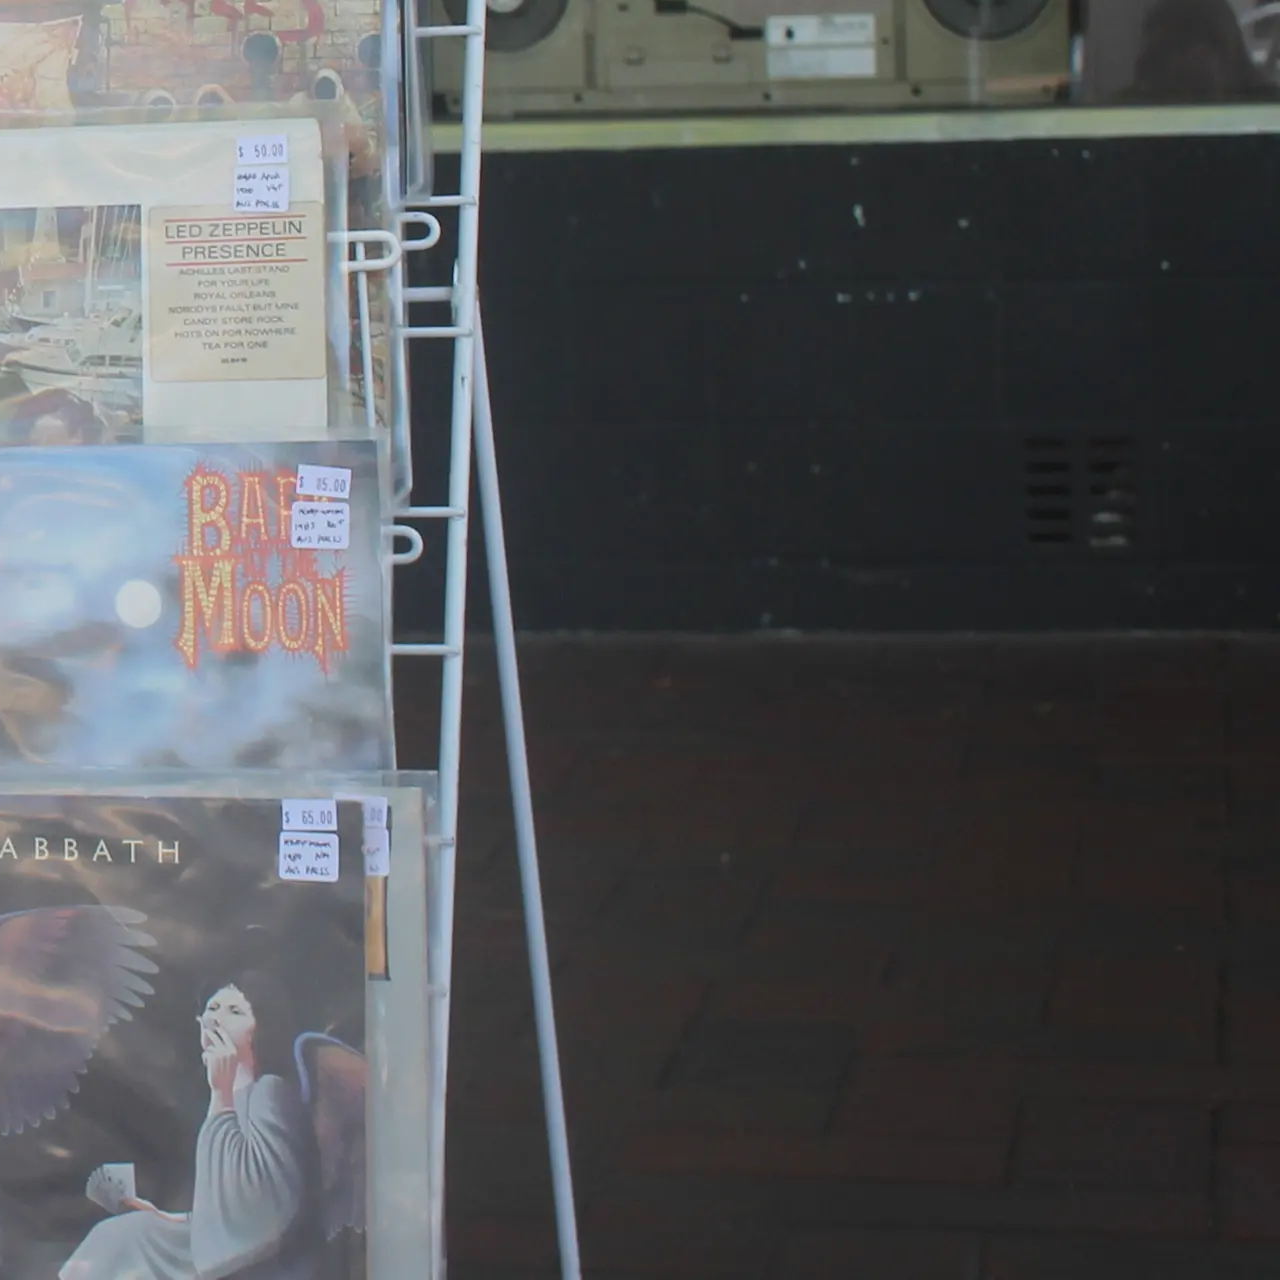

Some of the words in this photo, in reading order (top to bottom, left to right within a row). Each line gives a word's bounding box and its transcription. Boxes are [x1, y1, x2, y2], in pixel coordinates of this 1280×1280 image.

[254, 143, 284, 158] 50.00
[164, 223, 203, 239] LED
[208, 220, 303, 238] ZEPPELIN
[181, 242, 287, 260] PRESENCE
[178, 266, 226, 276] ACHILLES
[226, 265, 253, 275] LAST
[255, 264, 291, 274] STAND
[197, 279, 218, 288] FOR
[221, 278, 249, 288] YOUR
[250, 278, 271, 287] LIFE
[193, 291, 227, 301] ROYAL
[229, 290, 277, 300] ORLEANS
[219, 303, 251, 313] FAULT
[252, 302, 273, 312] BUT
[275, 302, 300, 311] MINE
[183, 318, 218, 326] CANDY
[222, 316, 253, 326] STORE
[256, 316, 285, 325] ROCK
[174, 330, 203, 339] HOTS
[204, 329, 220, 338] ON
[222, 329, 243, 338] FOR
[244, 326, 297, 337] NOWHERE
[202, 341, 221, 350] TEA
[223, 341, 244, 350] FOR
[246, 340, 269, 350] ONE
[177, 558, 346, 668] MOON
[301, 809, 333, 826] 65.00
